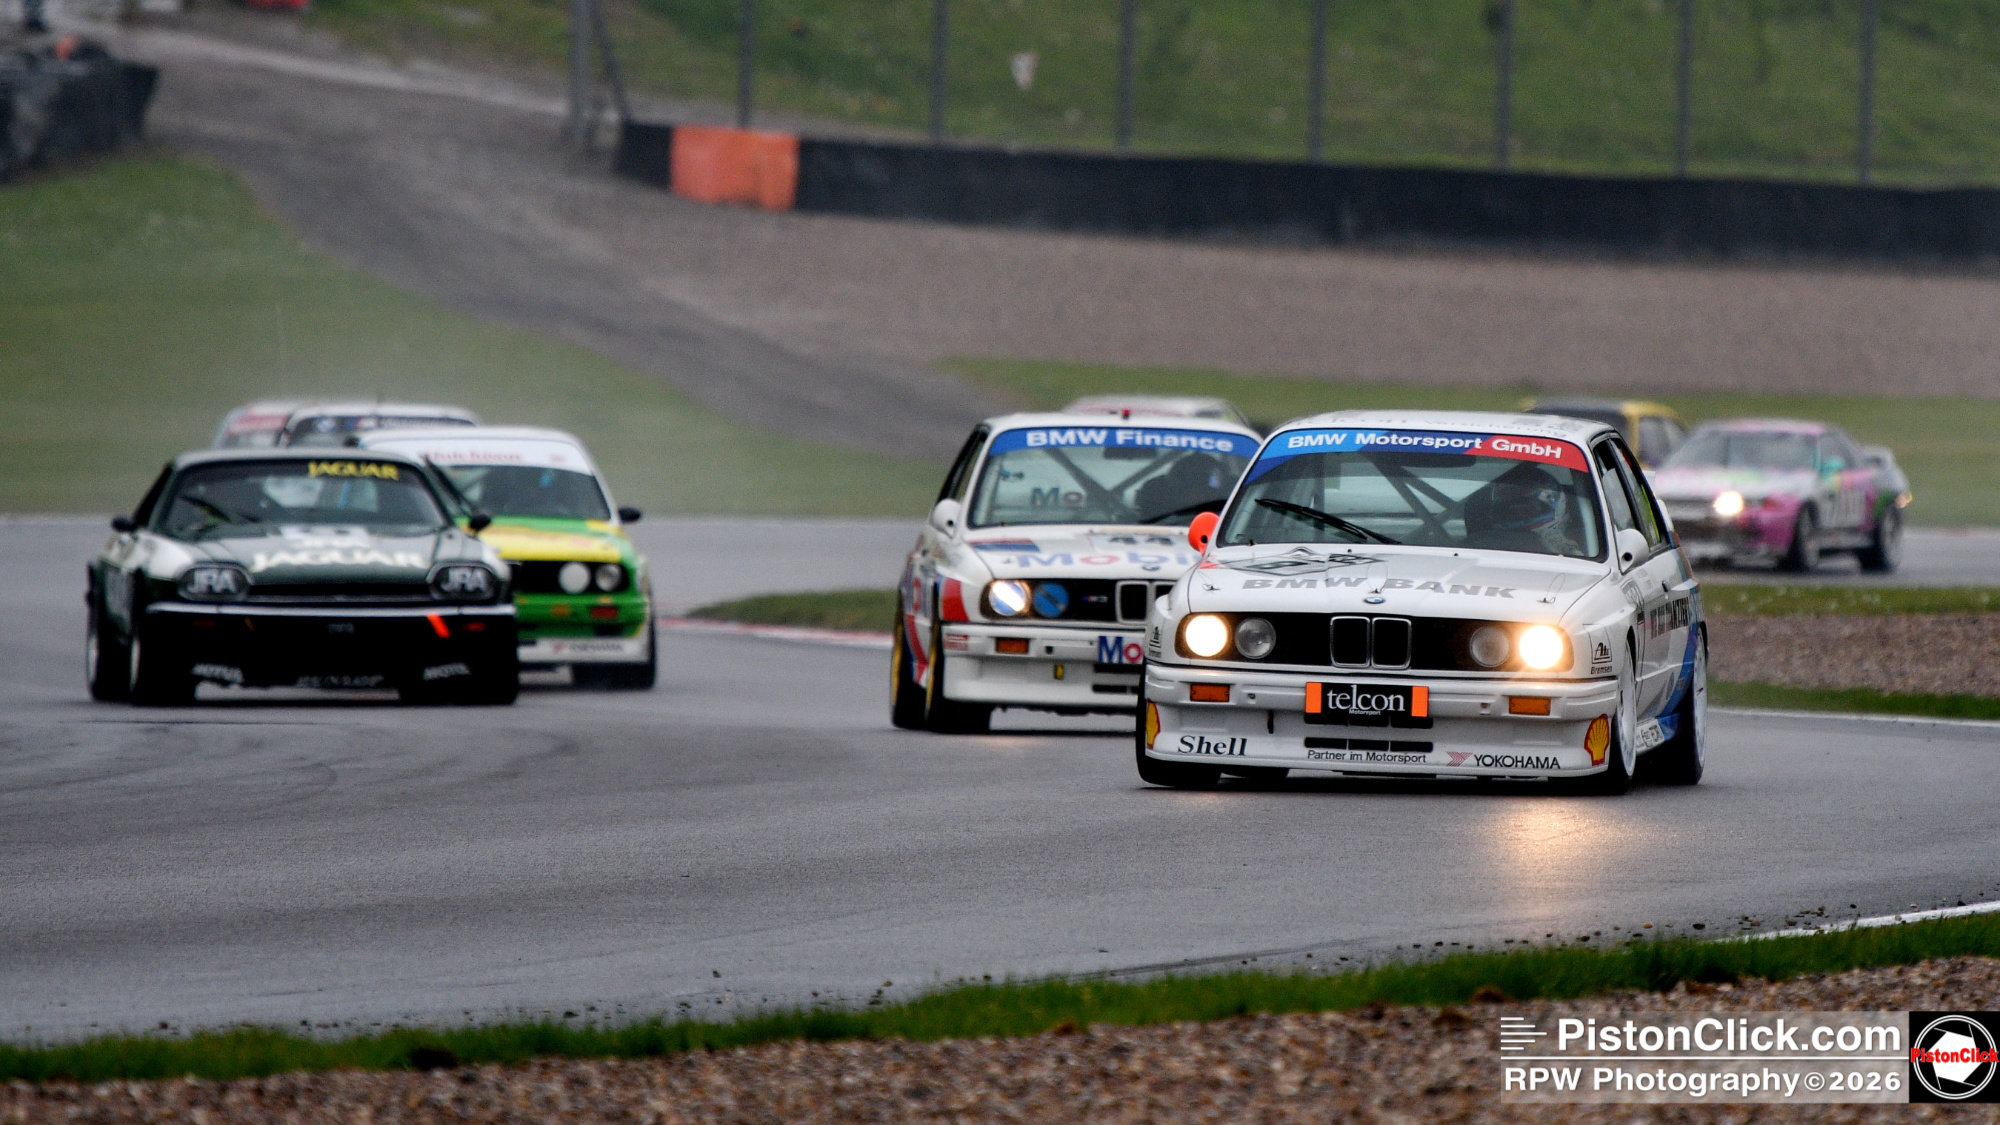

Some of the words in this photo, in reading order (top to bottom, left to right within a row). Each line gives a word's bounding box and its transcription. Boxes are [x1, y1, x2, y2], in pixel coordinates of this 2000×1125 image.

[1026, 429, 1108, 447] BMW
[1115, 431, 1234, 453] Finance
[1287, 433, 1347, 449] BMW
[1355, 433, 1482, 449] Motorsport
[1491, 438, 1562, 459] GmbH
[308, 460, 399, 481] JAGUAR
[252, 549, 427, 573] JAGUAR
[187, 568, 237, 594] JRA
[442, 566, 486, 592] JRA
[1242, 577, 1367, 589] BMW
[1384, 578, 1517, 598] BANK
[1327, 684, 1405, 711] telcon
[1178, 735, 1247, 756] Shell
[1307, 749, 1346, 760] Partner
[1350, 751, 1362, 761] im
[1366, 752, 1426, 764] Motorsport
[1474, 754, 1561, 769] YOKOHAMA
